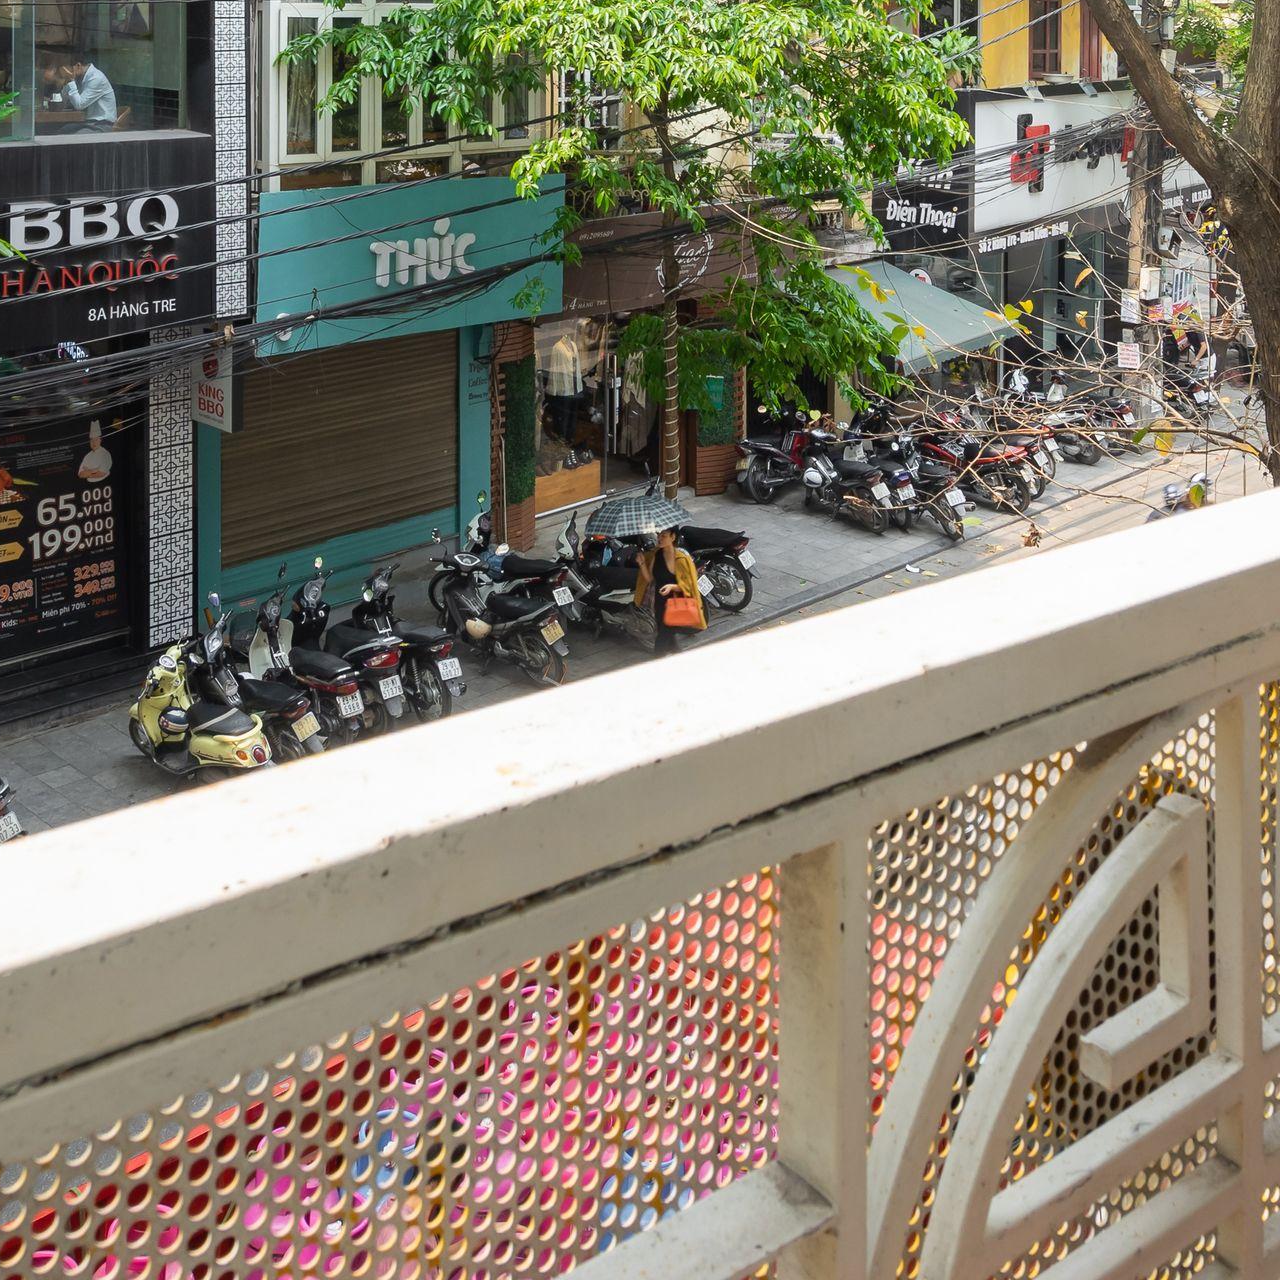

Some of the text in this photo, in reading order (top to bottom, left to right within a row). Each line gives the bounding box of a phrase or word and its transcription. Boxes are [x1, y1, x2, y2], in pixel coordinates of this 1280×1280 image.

[8, 191, 180, 251] BBQ
[886, 199, 957, 233] Điện Thoại
[88, 298, 176, 321] 8A HÀNG TRE
[198, 382, 225, 402] KING
[198, 397, 225, 418] BBQ
[71, 600, 87, 612] 70%
